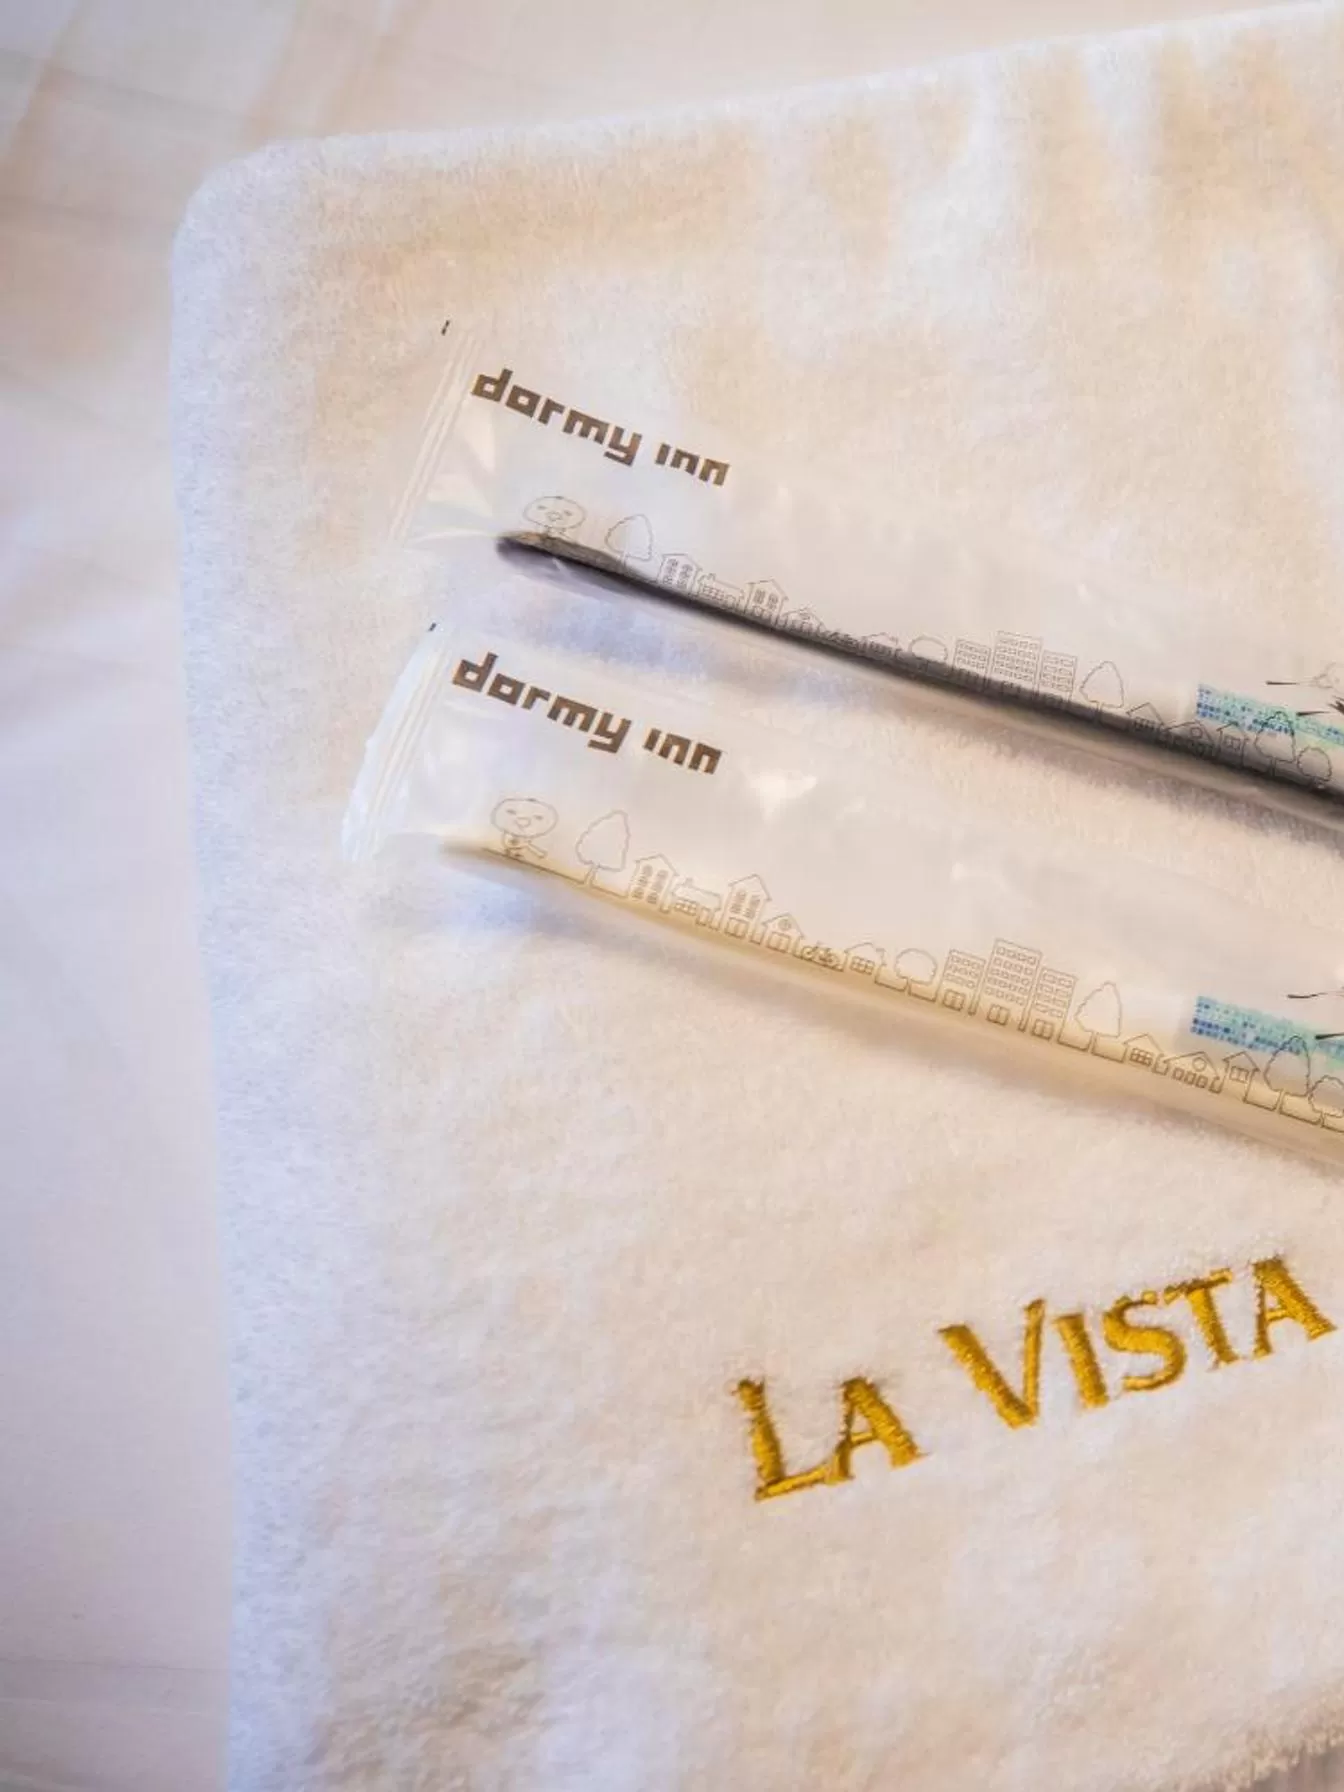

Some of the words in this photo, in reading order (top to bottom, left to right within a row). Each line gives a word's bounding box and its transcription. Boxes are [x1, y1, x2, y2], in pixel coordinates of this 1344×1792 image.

[471, 368, 642, 466] dormy
[654, 442, 730, 486] inn
[451, 652, 631, 753] dormy
[643, 728, 723, 774] inn
[732, 1375, 926, 1501] LA
[937, 1253, 1337, 1430] VISTA
